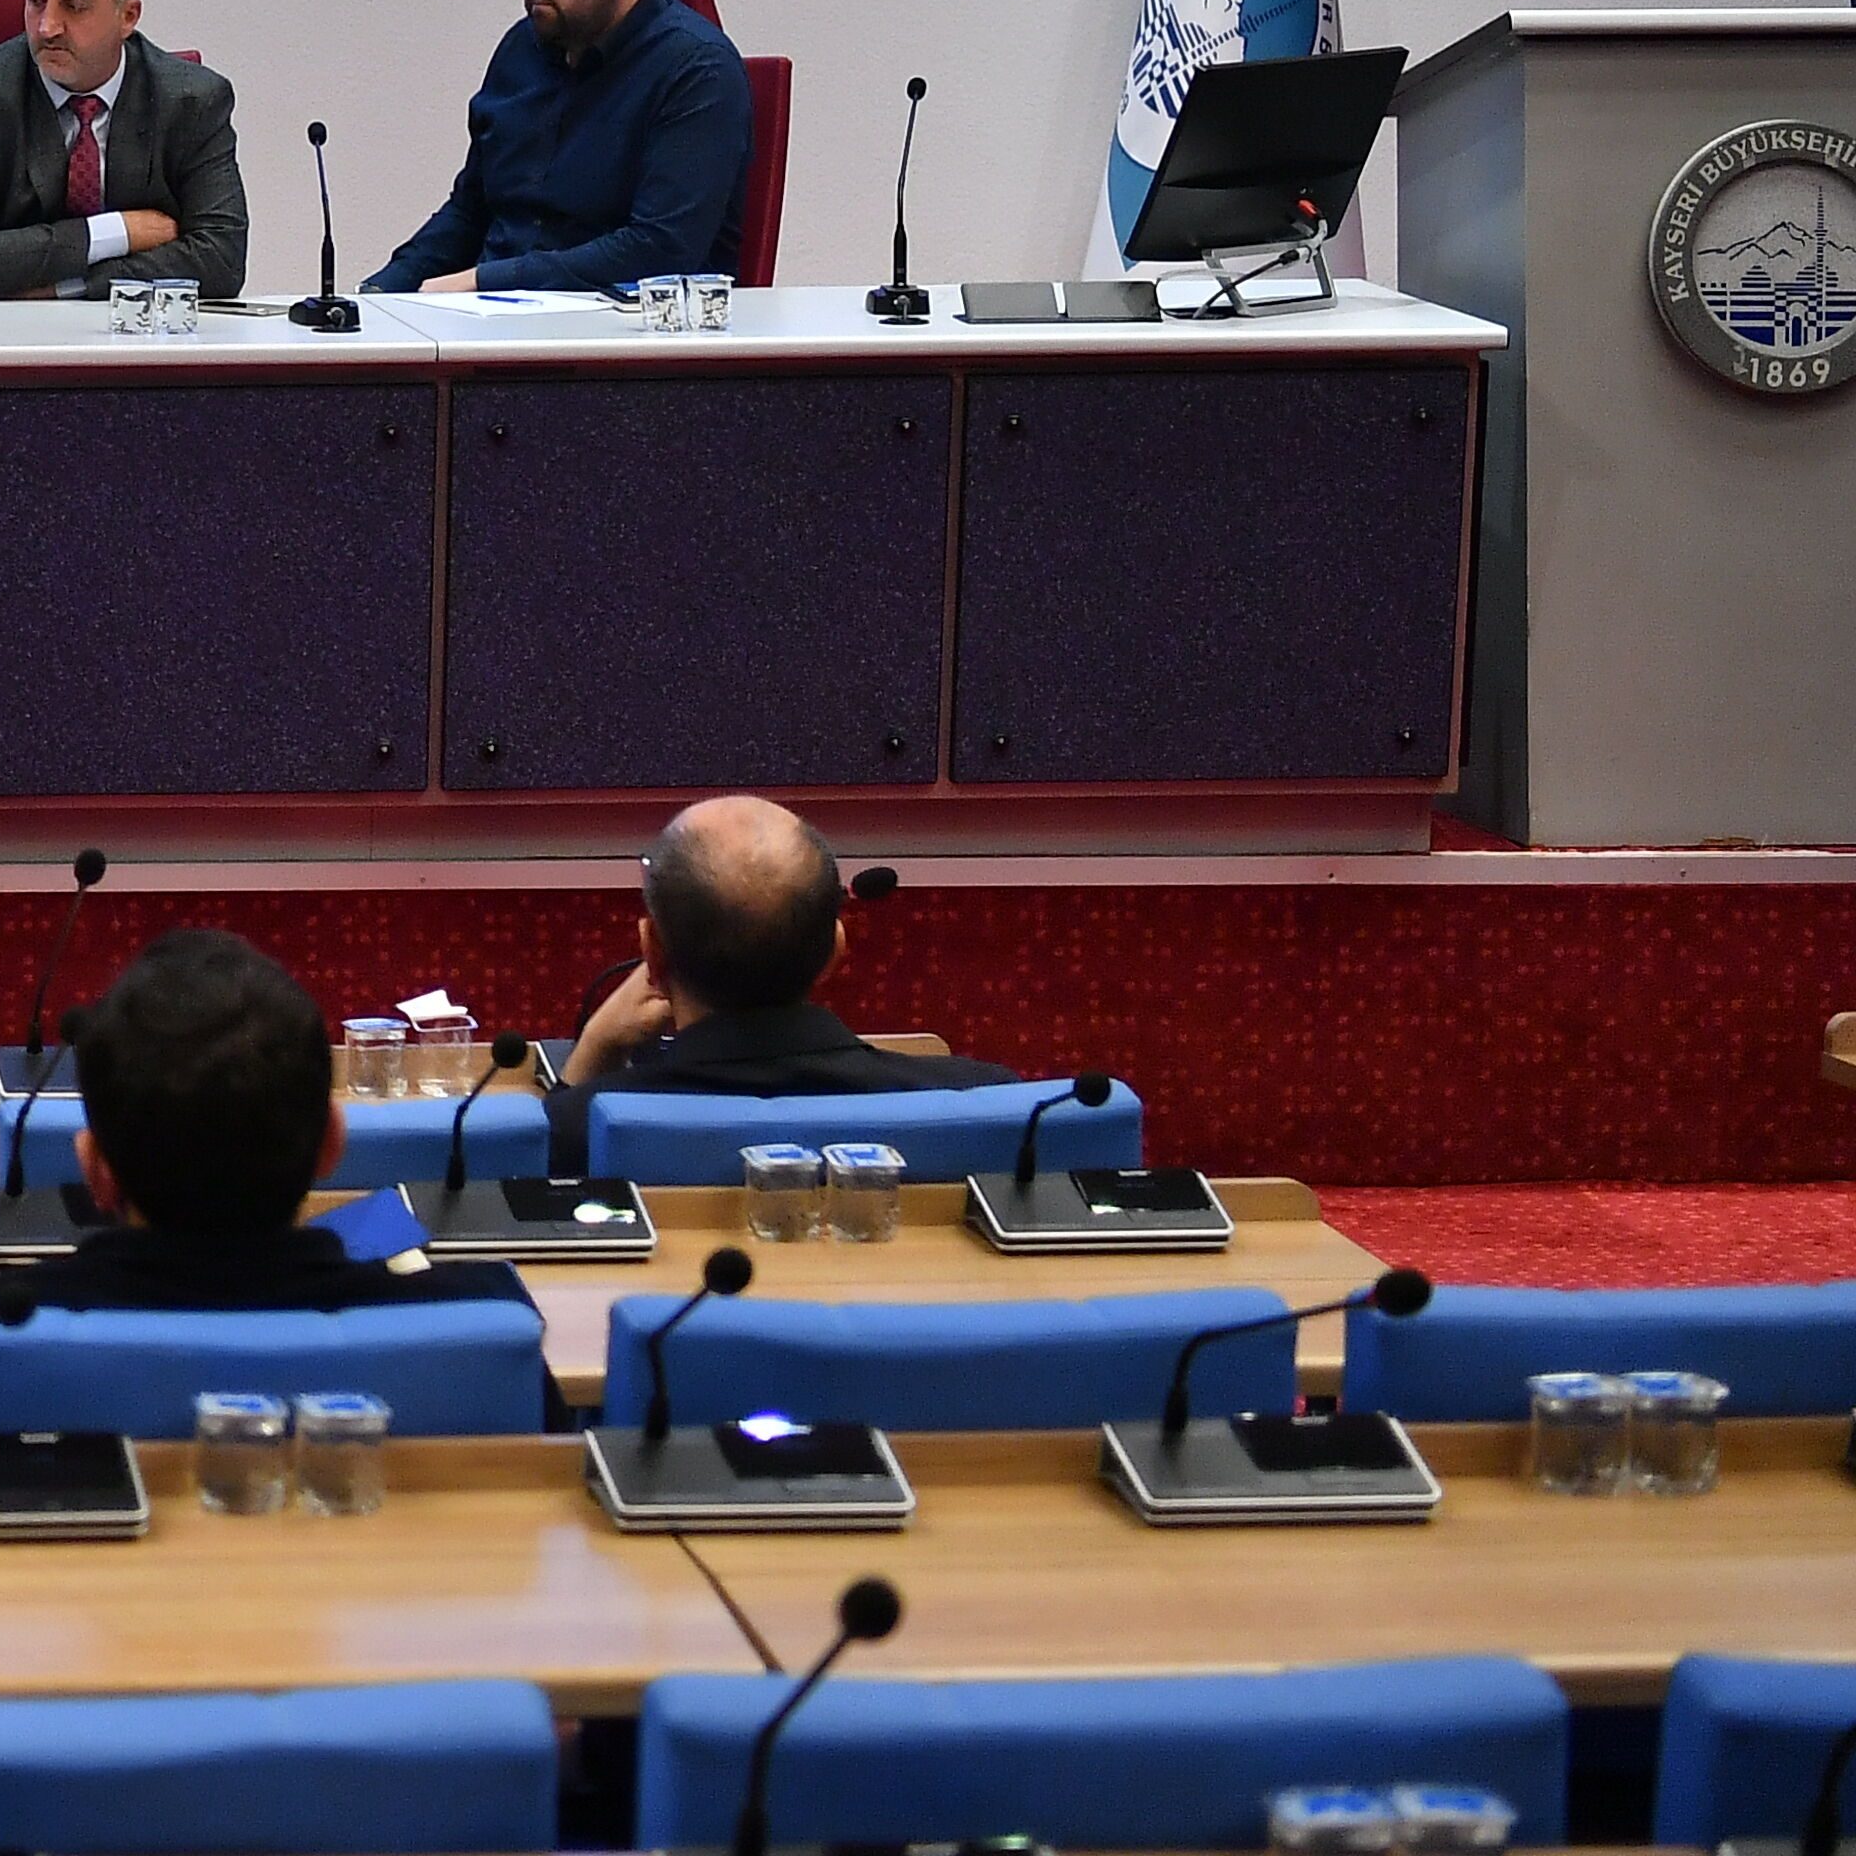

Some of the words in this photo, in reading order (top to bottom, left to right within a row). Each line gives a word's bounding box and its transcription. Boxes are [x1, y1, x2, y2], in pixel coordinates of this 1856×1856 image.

[1664, 179, 1704, 303] KAYSERİ
[1699, 130, 1856, 184] BÜYÜKŞEHİ
[1750, 358, 1830, 387] 1869
